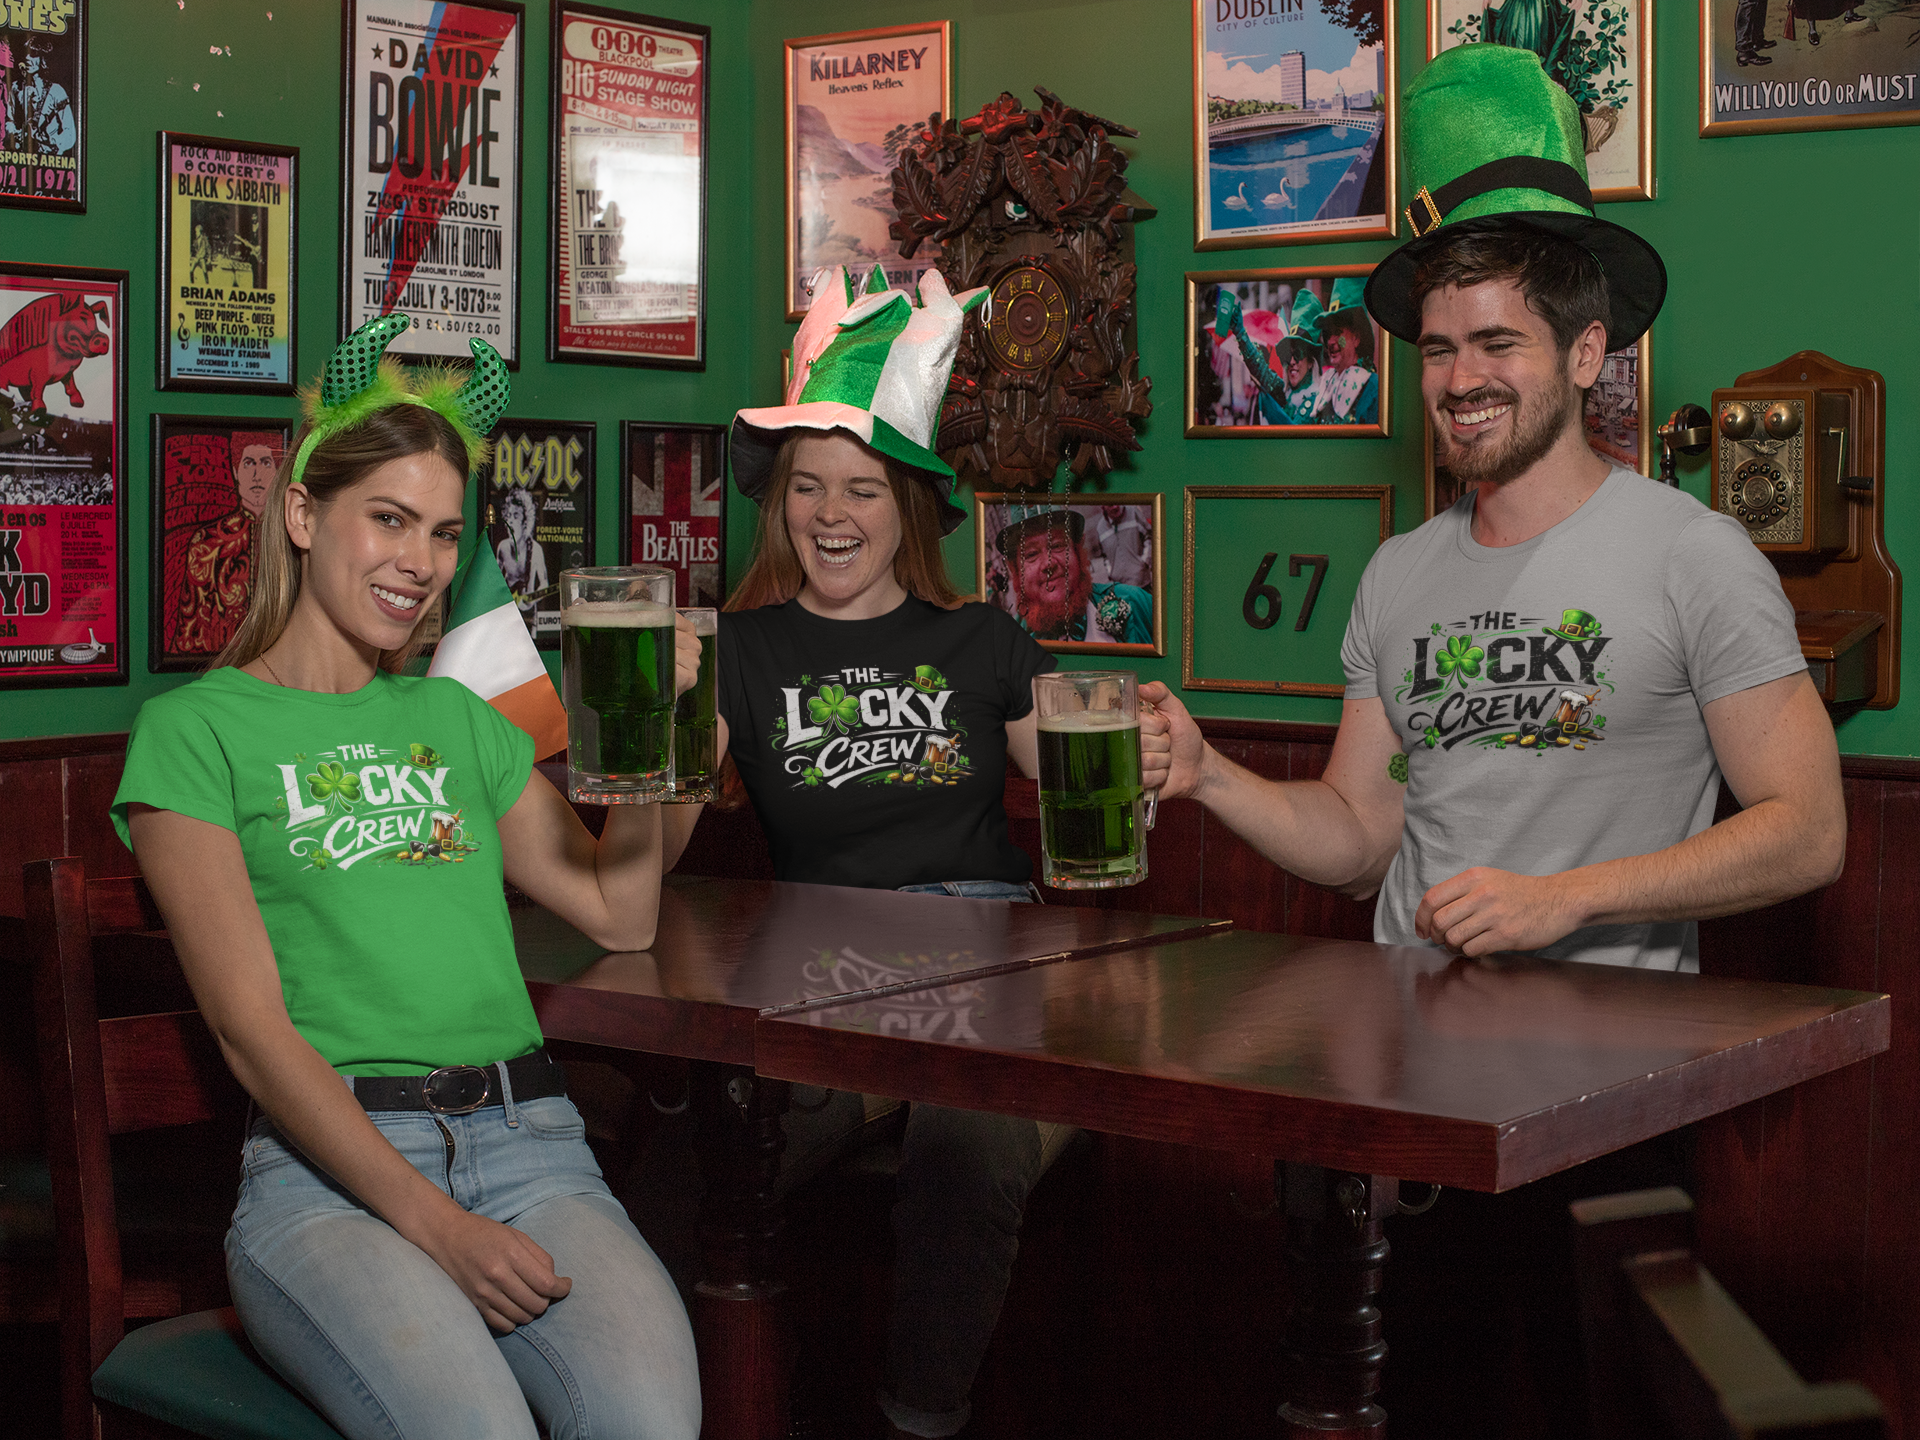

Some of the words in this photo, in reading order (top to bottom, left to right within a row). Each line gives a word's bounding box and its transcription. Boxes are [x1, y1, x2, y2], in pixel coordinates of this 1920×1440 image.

[366, 15, 396, 26] MAINMAN
[404, 22, 436, 33] association
[1216, 22, 1238, 32] CITY
[1244, 19, 1257, 28] OF
[1263, 13, 1304, 25] CULTURE
[388, 38, 484, 80] DAVID
[658, 45, 683, 56] THEATRE
[599, 52, 654, 70] BLACKPOOL
[810, 47, 928, 81] KILLARNEY
[562, 58, 595, 98] BIG
[599, 69, 654, 90] SUNDAY
[656, 79, 696, 96] NIGHT
[873, 78, 904, 90] Reflex
[598, 86, 646, 107] STAGE
[651, 95, 696, 115] SHOW
[1715, 84, 1762, 112] WILL
[1761, 81, 1798, 109] YOU
[1803, 77, 1831, 106] GO
[1835, 84, 1855, 104] OR
[1858, 74, 1917, 102] MUST
[368, 71, 501, 188] BOWIE
[0, 151, 38, 166] SPORTS
[40, 154, 76, 170] ARENA
[181, 146, 209, 160] ROCK
[214, 150, 232, 162] AID
[236, 152, 279, 168] ARMENIA
[36, 168, 76, 191] 1972
[198, 162, 264, 179] CONCERT
[178, 173, 218, 198] BLACK
[226, 178, 280, 205] SABBATH
[402, 184, 454, 198] PERFORMING
[456, 190, 466, 200] AS
[367, 190, 414, 211] ZIGGY
[418, 197, 499, 221] STARDUST
[364, 216, 459, 266] HAMMERSMITH
[463, 226, 502, 270] ODEON
[578, 235, 596, 265] THE
[416, 266, 447, 275] CAROLINE
[449, 268, 457, 276] ST
[460, 269, 485, 279] LONDON
[581, 271, 607, 279] GEORGE
[181, 286, 224, 300] BRIAN
[228, 290, 276, 304] ADAMS
[487, 304, 500, 312] P.M.
[579, 300, 591, 310] THE
[195, 308, 214, 320] DEEP
[216, 310, 244, 323] PURPLE
[252, 313, 275, 325] QUEEN
[196, 322, 217, 334] PINK
[221, 324, 249, 336] FLOYD
[257, 326, 274, 338] YES
[426, 318, 500, 335] £1.50/£2.00
[564, 326, 591, 334] STALLS
[627, 330, 654, 339] CIRCLE
[202, 335, 226, 347] IRON
[231, 337, 268, 350] MAIDEN
[198, 347, 235, 357] WEMBLEY
[238, 350, 271, 359] STADIUM
[165, 446, 229, 470] PINK
[492, 432, 584, 492] AC/DC
[7, 513, 26, 526] en
[29, 512, 47, 526] os
[72, 512, 112, 520] MERCREDI
[669, 521, 690, 537] THE
[537, 535, 584, 544] NATIONA(A)L
[642, 523, 718, 569] BEATLES
[1242, 552, 1329, 632] 67
[1470, 611, 1516, 630] THE
[841, 668, 881, 684] THE
[1407, 635, 1613, 700] LCKY
[781, 684, 954, 748] LCKY
[1434, 688, 1556, 737] CREW
[336, 744, 378, 761] THE
[816, 732, 921, 777] CREW
[275, 763, 450, 829] LCKY
[323, 809, 425, 859] CREW
